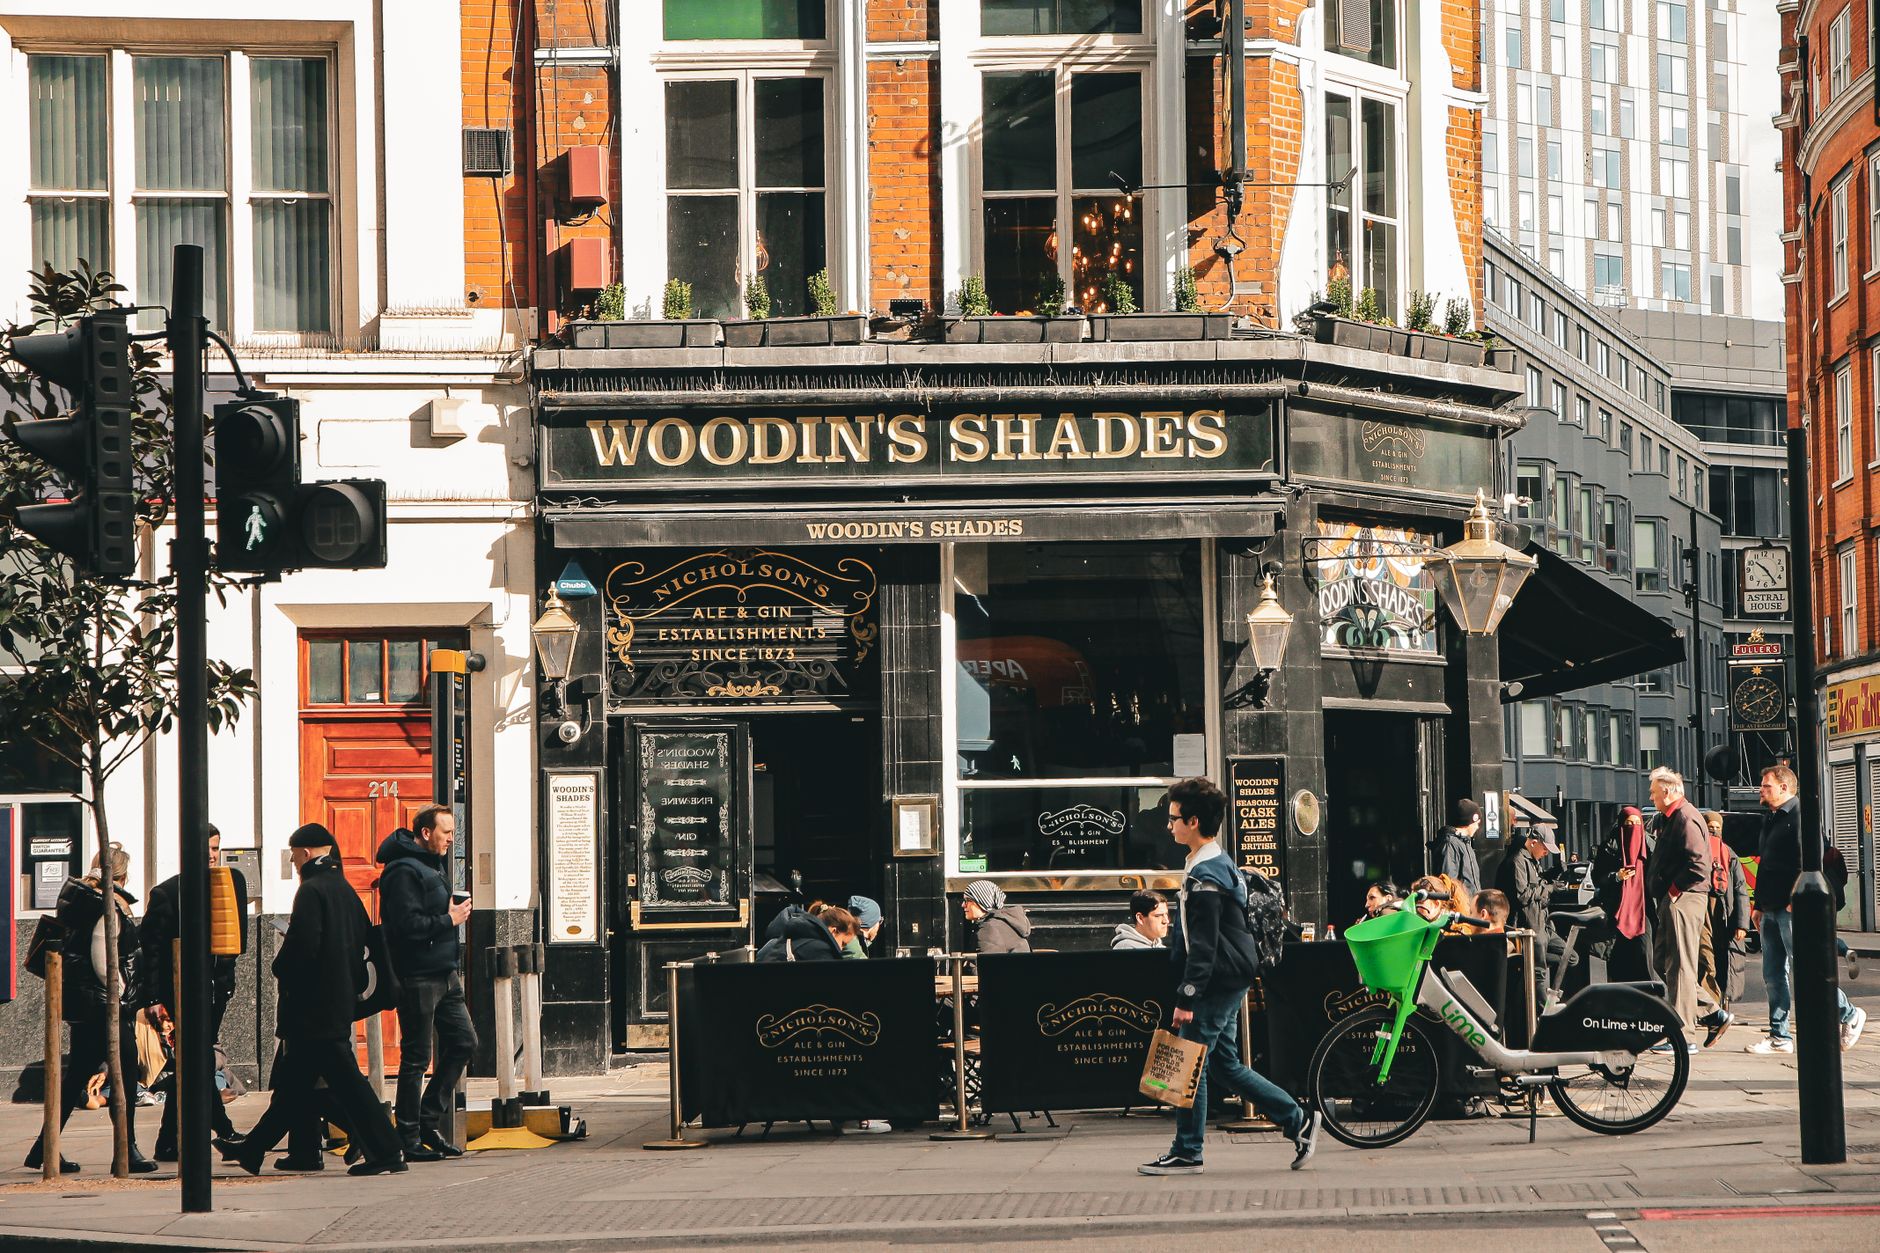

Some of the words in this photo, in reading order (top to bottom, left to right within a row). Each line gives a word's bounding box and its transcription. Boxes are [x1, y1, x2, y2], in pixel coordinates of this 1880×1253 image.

[586, 413, 928, 467] WOODIN'S
[950, 410, 1228, 462] SHADES
[1368, 426, 1420, 449] NICHOLSON'S
[1381, 449, 1391, 457] ALE
[1372, 460, 1417, 471] ESTABLISHMENTS
[1380, 473, 1396, 482] SINCE
[806, 521, 924, 539] WOODIN'S
[930, 519, 1023, 537] SHADES
[652, 562, 830, 602] NICHOLSON'S
[1747, 593, 1785, 602] ASTRAL
[1369, 580, 1425, 627] SHADES
[1750, 602, 1782, 610] HOUSE
[692, 606, 727, 618] ALE
[737, 606, 748, 618] &
[758, 606, 792, 618] GIN
[658, 626, 826, 641] ESTABLISHMENTS
[691, 648, 748, 661] SINCE
[758, 648, 796, 660] 1873
[1235, 778, 1279, 786] WOODIN'S
[368, 781, 399, 798] 214
[552, 785, 595, 793] WOODIN'S
[1239, 788, 1275, 796] SHADES
[1240, 808, 1277, 818] CASK
[1240, 819, 1276, 829] ALES
[1245, 855, 1273, 865] PUB
[1050, 1003, 1151, 1027] NICHOLSON'S
[769, 1015, 869, 1038] NICHOLSON'S
[1441, 999, 1486, 1048] Lime
[1583, 1017, 1600, 1029] On
[1601, 1019, 1628, 1030] Lime
[1638, 1021, 1665, 1033] Uber
[1074, 1029, 1093, 1037] ALE
[1097, 1029, 1103, 1037] &
[1108, 1029, 1126, 1037] GIN
[794, 1041, 812, 1049] ALE
[1057, 1041, 1144, 1052] ESTABLISHMENTS
[777, 1054, 863, 1063] ESTABLISHMENTS
[1074, 1057, 1104, 1065] SINCE
[1108, 1055, 1128, 1064] 1873
[794, 1069, 823, 1077] SINCE
[828, 1068, 847, 1076] 1873
[1185, 1056, 1202, 1098] LUSH
